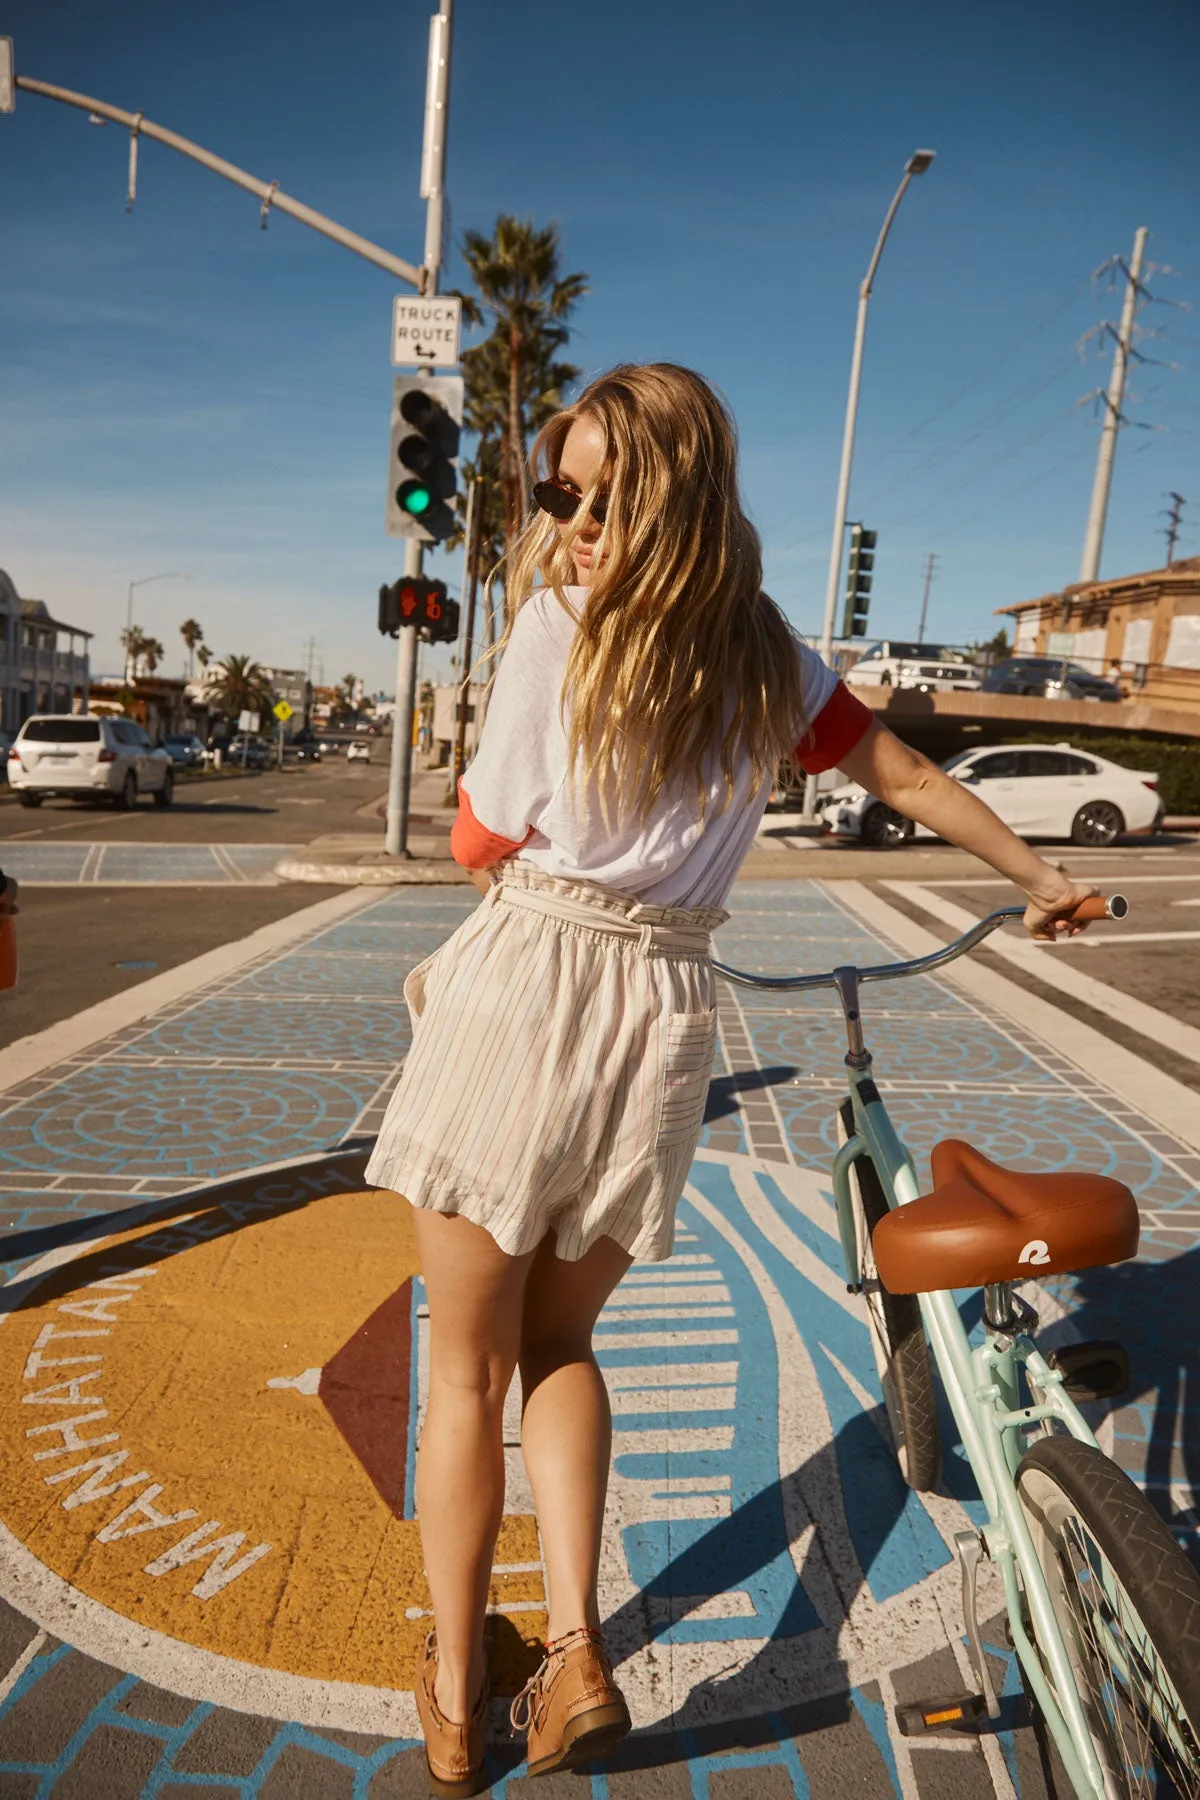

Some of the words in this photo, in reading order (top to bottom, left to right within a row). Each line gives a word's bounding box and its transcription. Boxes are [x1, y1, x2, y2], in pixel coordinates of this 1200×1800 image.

[398, 326, 453, 342] ROUTE
[400, 306, 455, 321] TRUCK
[132, 1169, 356, 1254] BEACH
[21, 1263, 273, 1600] MANHATTAN
